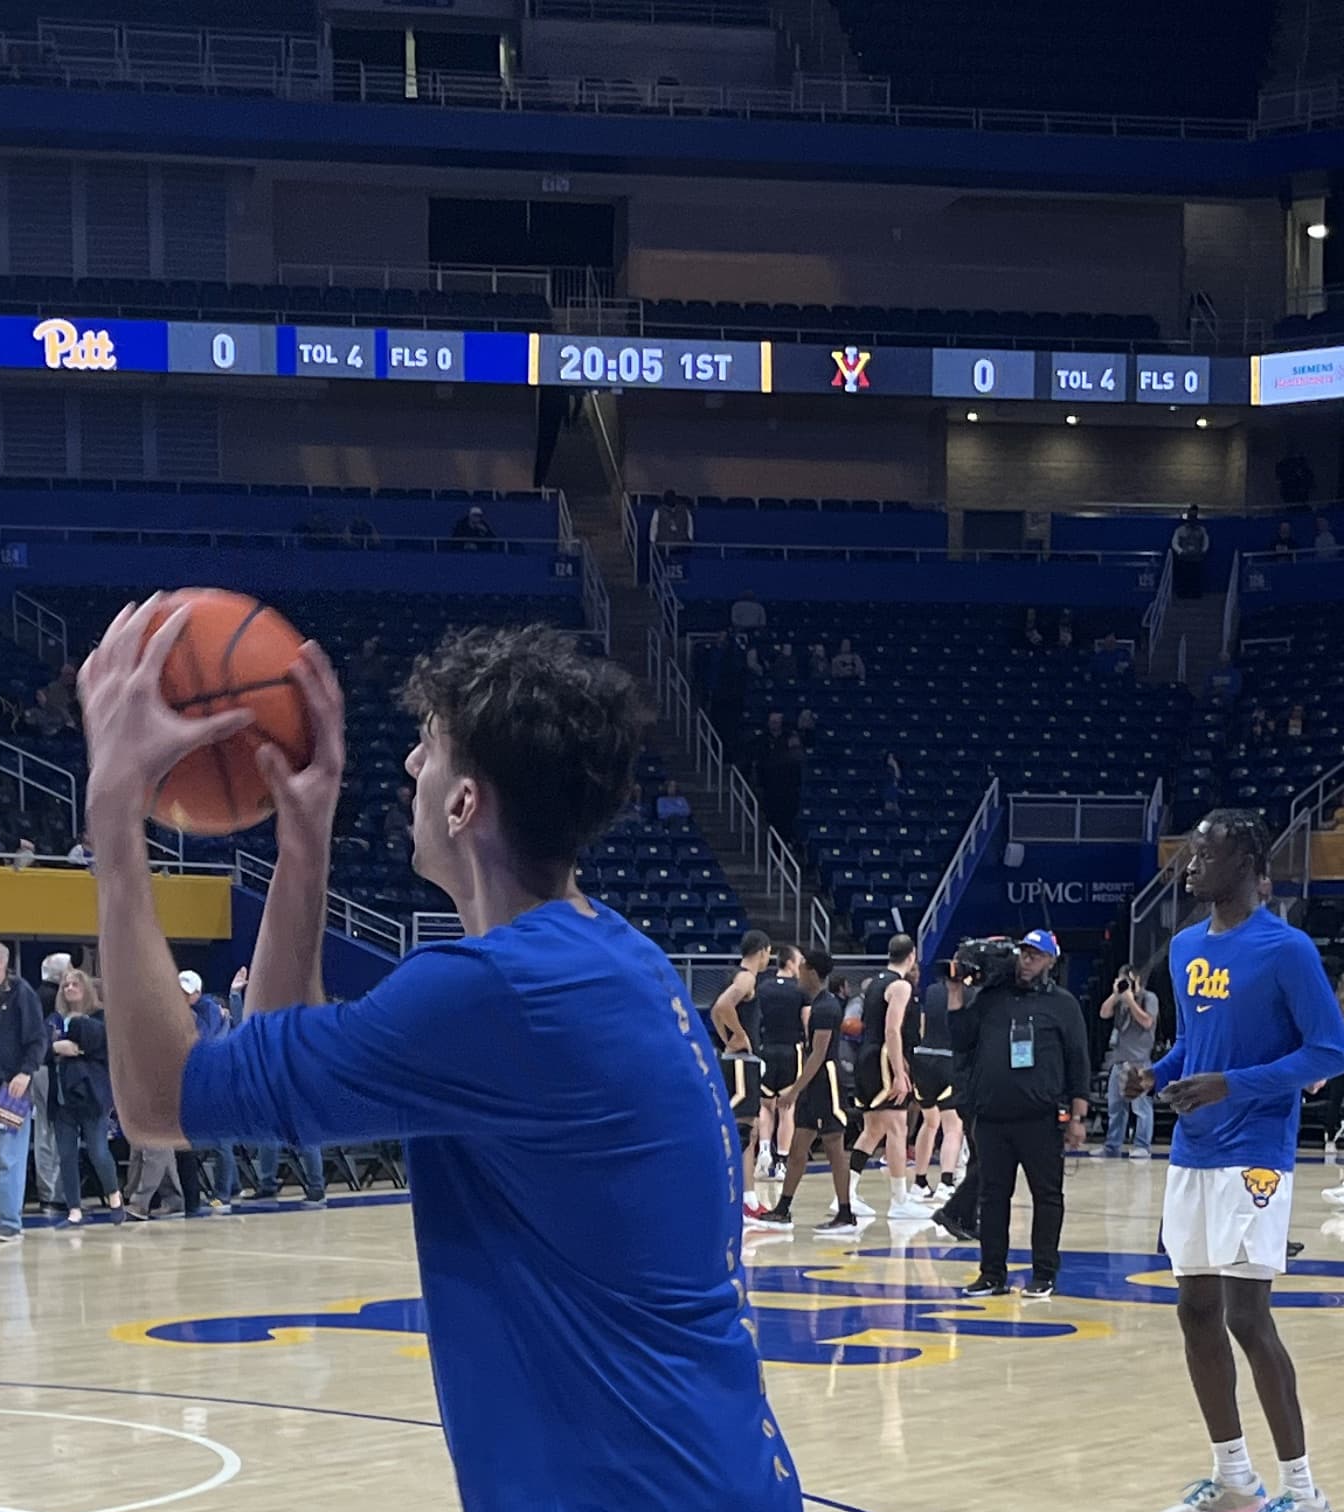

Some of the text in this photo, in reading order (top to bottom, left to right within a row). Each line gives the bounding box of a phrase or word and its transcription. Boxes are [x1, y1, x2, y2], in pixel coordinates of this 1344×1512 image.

[32, 318, 118, 371] Pitt
[211, 332, 236, 369] 0
[298, 343, 364, 368] TOL 4
[390, 346, 452, 371] FLS 0
[559, 344, 733, 384] 20:05 1ST
[972, 358, 995, 393] 0
[1056, 367, 1115, 391] TOL 4
[1139, 370, 1199, 393] FLS 0
[1007, 881, 1084, 904] UPMC
[1185, 957, 1230, 1000] Pitt
